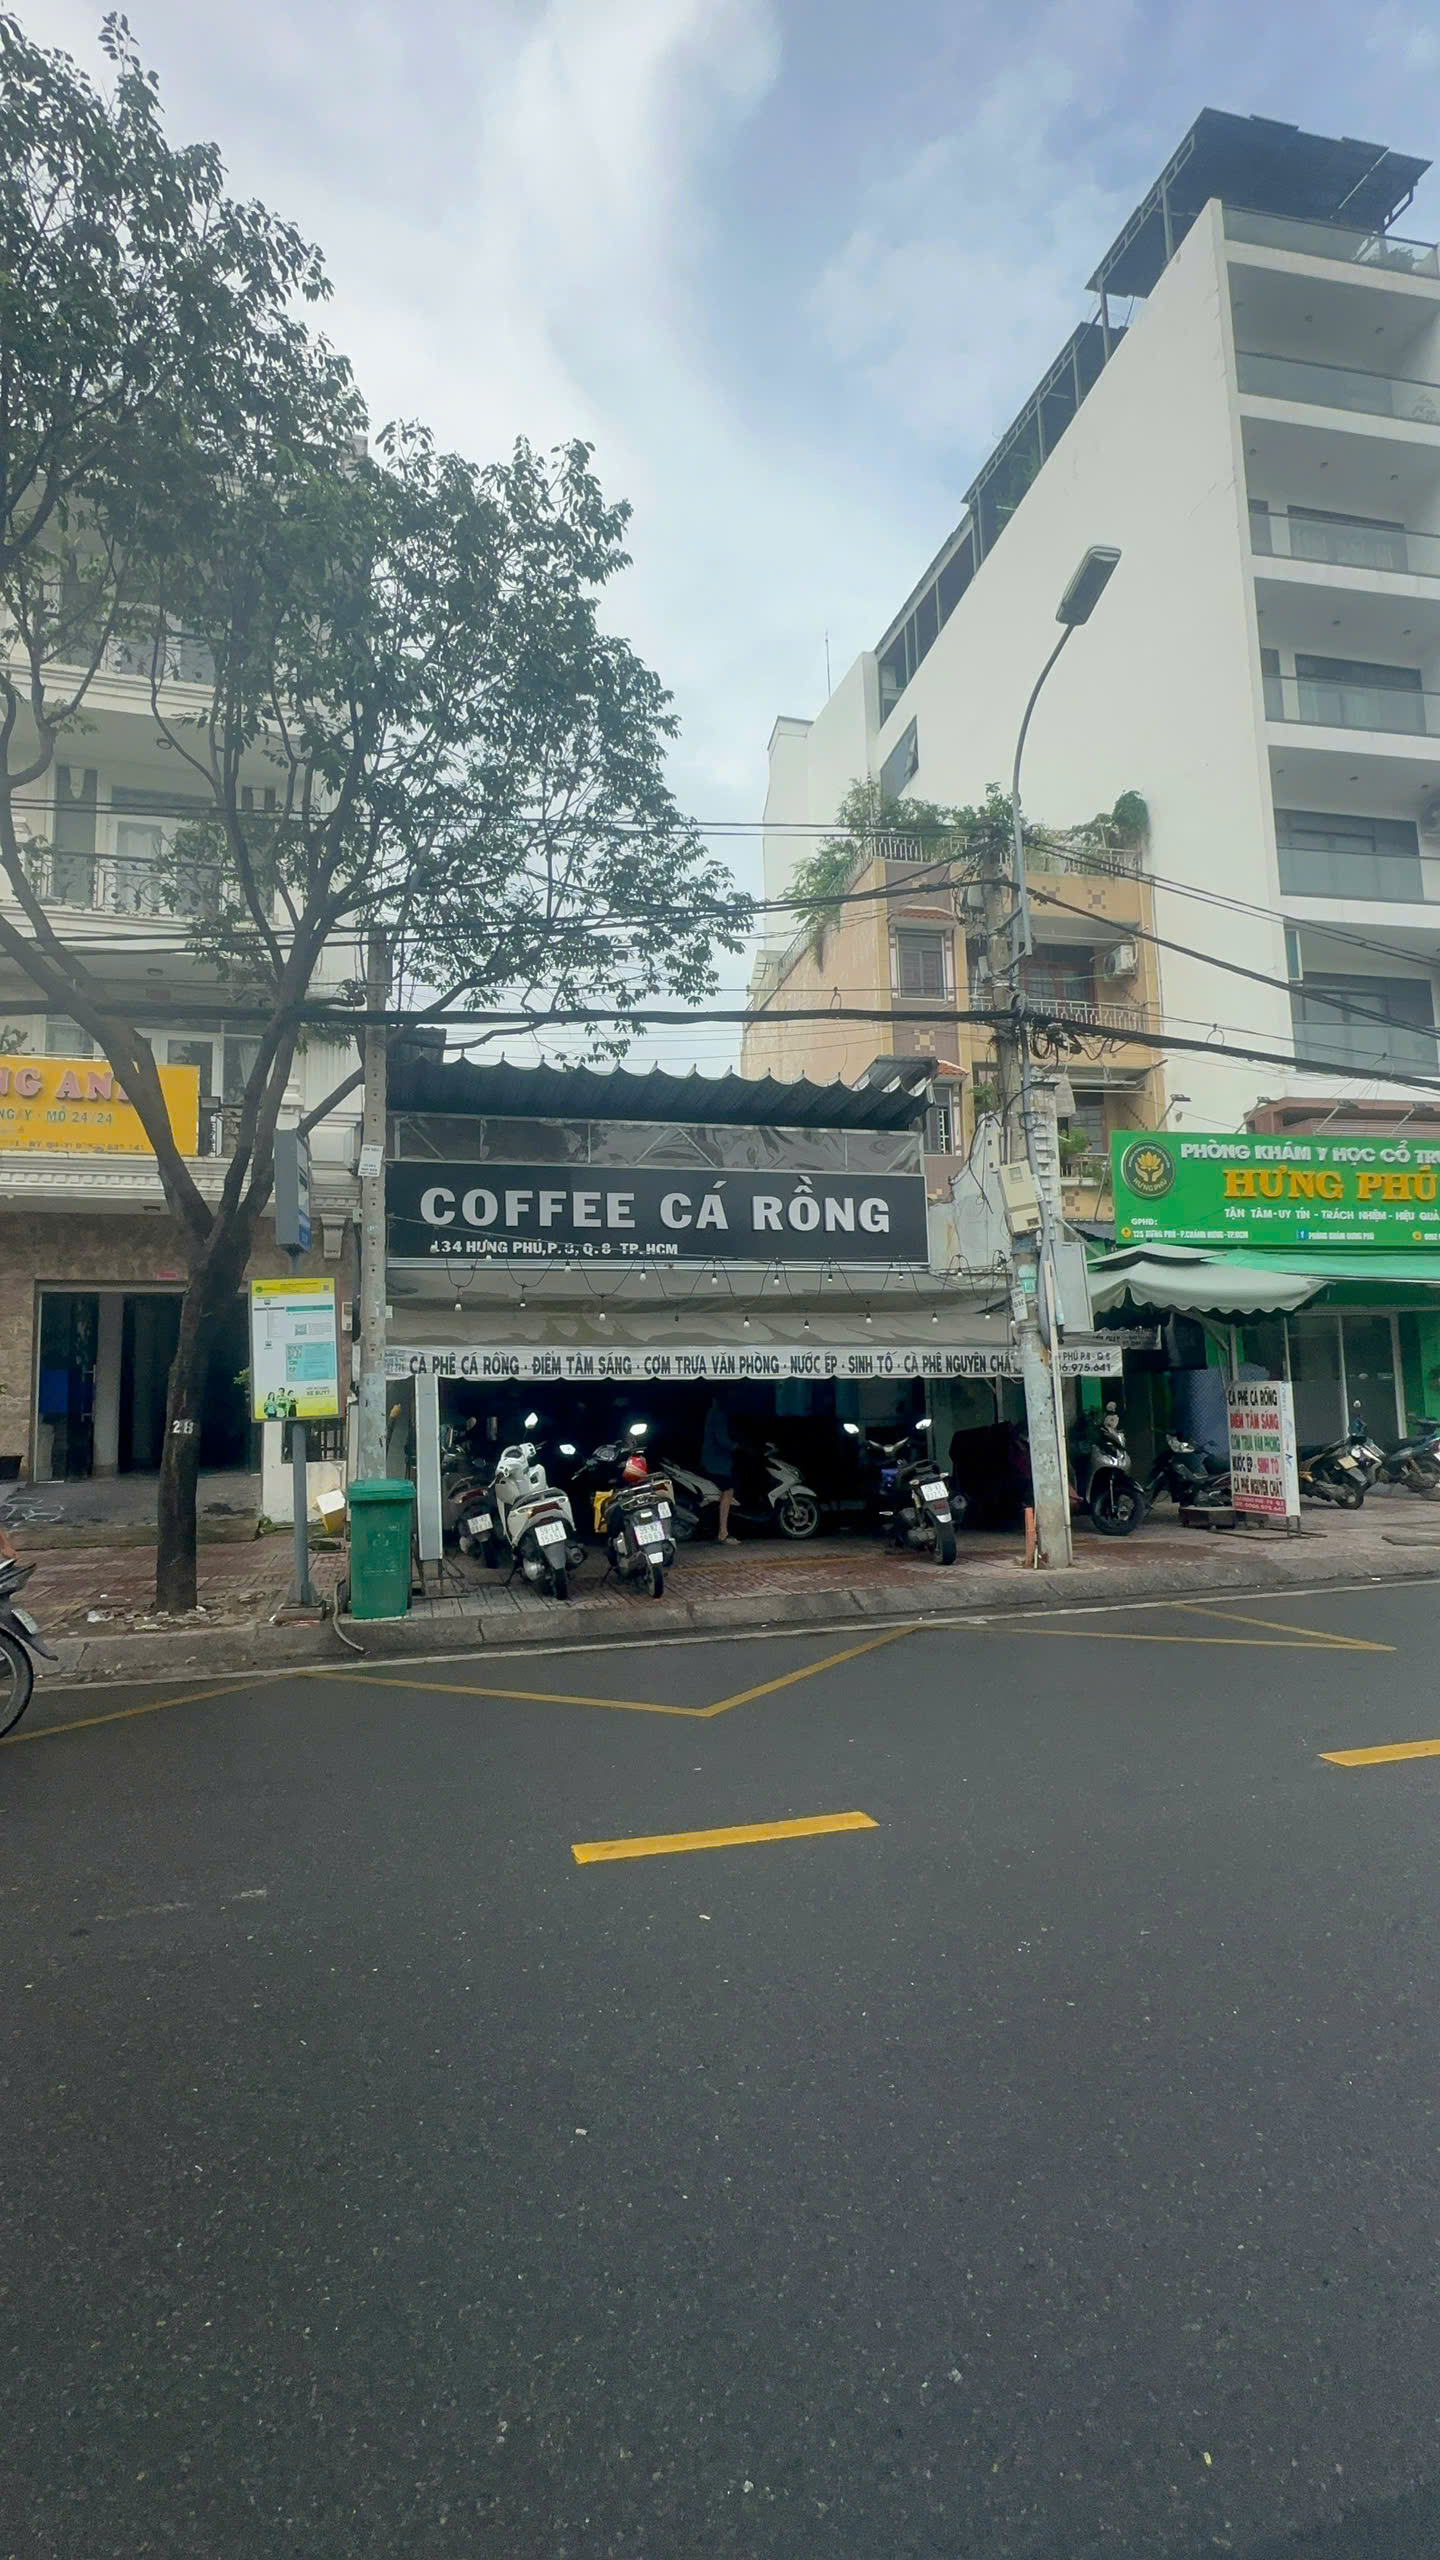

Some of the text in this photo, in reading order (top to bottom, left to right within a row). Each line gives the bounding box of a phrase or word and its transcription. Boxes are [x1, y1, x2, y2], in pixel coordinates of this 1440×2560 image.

[56, 1070, 129, 1100] AN
[1180, 1139, 1250, 1160] PHÒNG
[1254, 1141, 1312, 1161] KHÁM
[1315, 1147, 1329, 1161] Y
[1332, 1147, 1376, 1167] HỌC
[1379, 1140, 1410, 1163] CỔ
[1223, 1165, 1438, 1202] HƯNG PHÚ
[420, 1176, 890, 1234] COFFEE CÁ RỒNG
[1321, 1208, 1354, 1220] TRÁCH
[1359, 1209, 1387, 1222] NHIỆM
[466, 1239, 508, 1254] HƯNG
[409, 1352, 427, 1375] CÀ
[432, 1352, 456, 1375] PHÊ
[461, 1351, 478, 1375] CÁ
[483, 1351, 519, 1375] RỒNG
[532, 1350, 561, 1375] ĐIỂM
[566, 1352, 594, 1375] TÂM
[598, 1352, 632, 1375] SÁNG
[644, 1354, 670, 1375] CƠM
[675, 1355, 707, 1375] TRƯA
[711, 1352, 735, 1374] VĂN
[739, 1352, 780, 1374] PHÒNG
[791, 1351, 820, 1374] NƯỚC
[824, 1351, 837, 1374] ÉP
[848, 1355, 873, 1374] SINH
[876, 1351, 897, 1374] TỐ
[904, 1351, 919, 1374] CÀ
[922, 1352, 942, 1374] PHÊ
[946, 1352, 986, 1373] NGUYÊN
[1063, 1350, 1078, 1361] PHÚ
